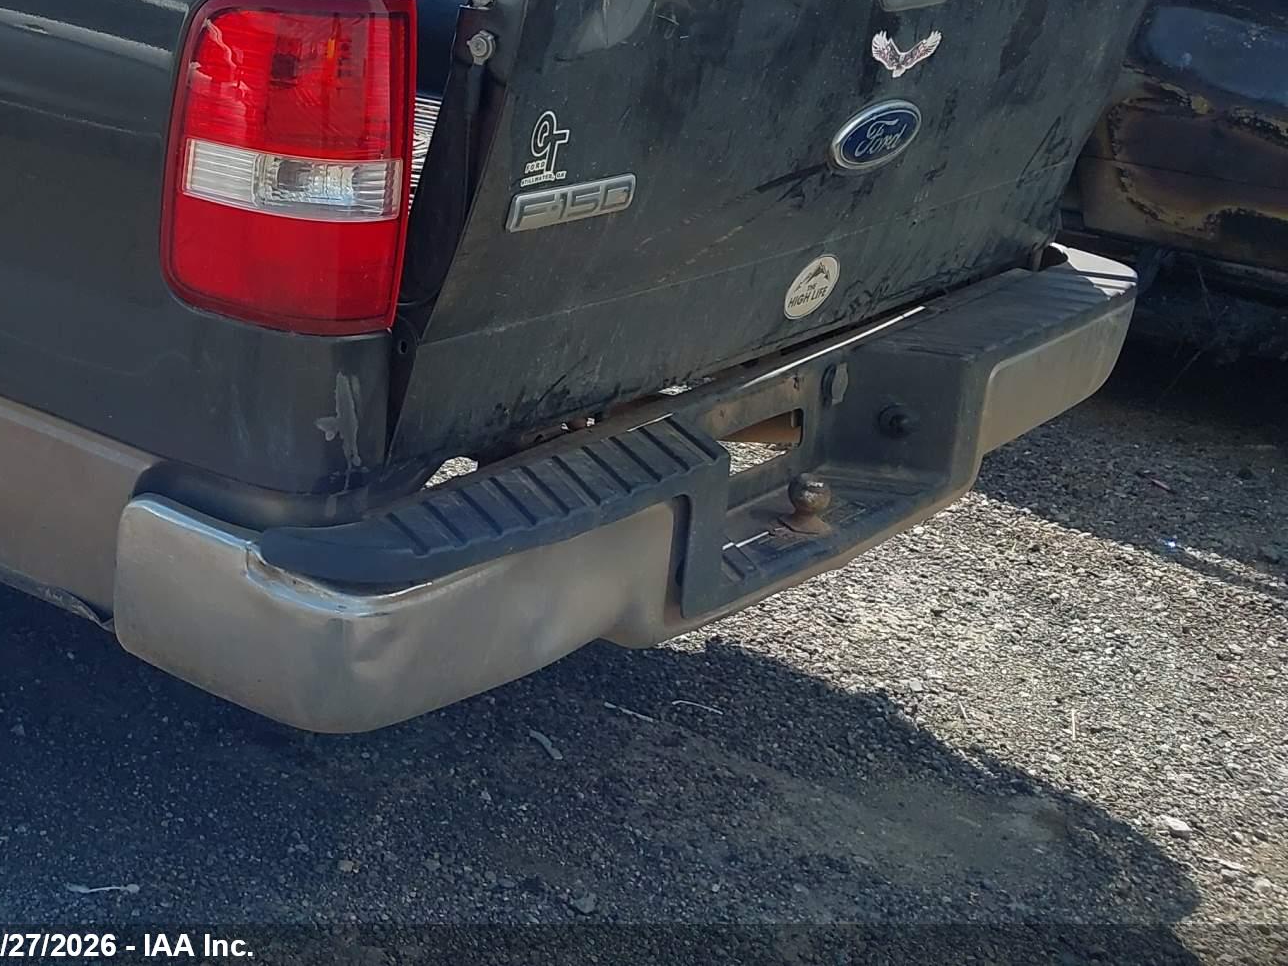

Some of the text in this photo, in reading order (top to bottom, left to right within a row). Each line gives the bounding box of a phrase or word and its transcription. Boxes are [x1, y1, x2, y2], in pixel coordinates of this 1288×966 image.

[854, 118, 908, 158] Ford
[524, 159, 547, 174] FORD
[807, 282, 818, 291] THE
[787, 285, 828, 308] HIGH LIFE
